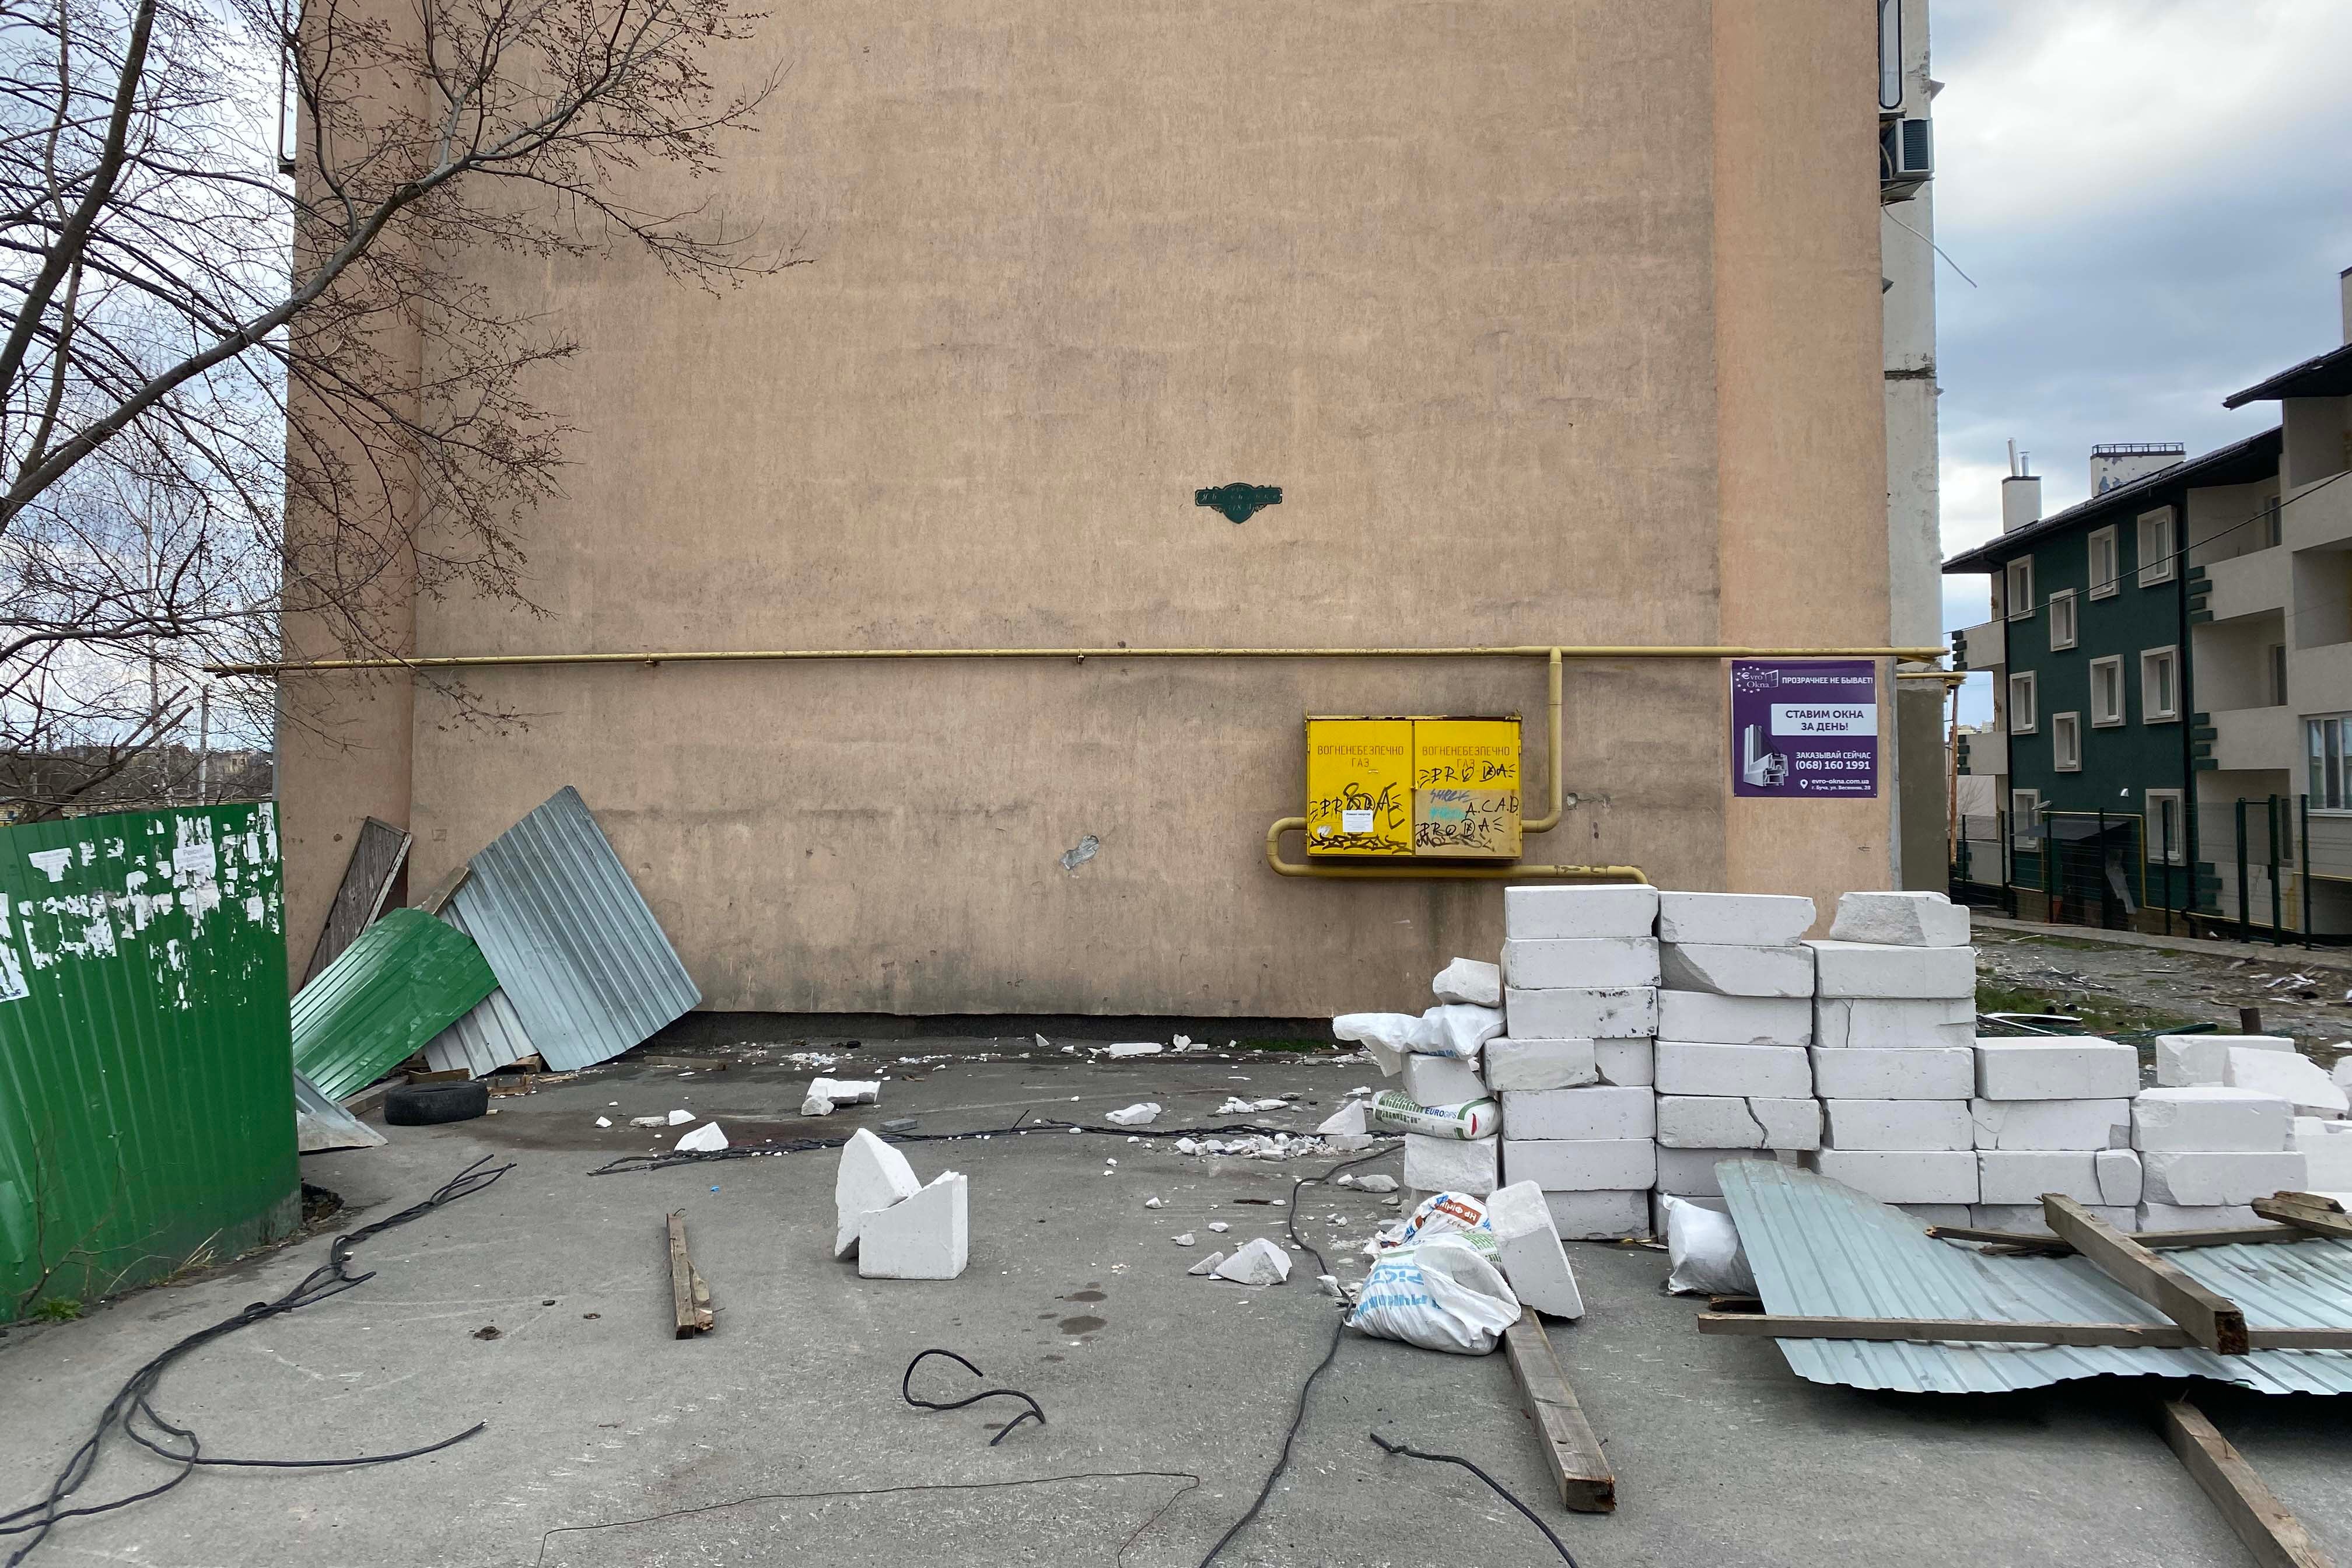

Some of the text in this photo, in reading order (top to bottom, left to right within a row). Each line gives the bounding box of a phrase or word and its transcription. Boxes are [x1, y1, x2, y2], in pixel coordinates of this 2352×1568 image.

[1786, 710, 1864, 719] СТАВИМ ОКНА
[1801, 722, 1849, 732] ЗА ДЕНЬ!
[1317, 745, 1404, 755] ВОГНЕНЕБЕЗПЕЧНО
[1422, 746, 1510, 756] ВОГНЕНЕБЕЗПЕЧНО
[1796, 751, 1871, 759] ЗАКАЗЫВАЙ СЕЙЧАС
[1352, 758, 1369, 768] ГАЗ
[1457, 758, 1475, 768] ГАЗ
[1796, 761, 1871, 770] (068) 160 1991
